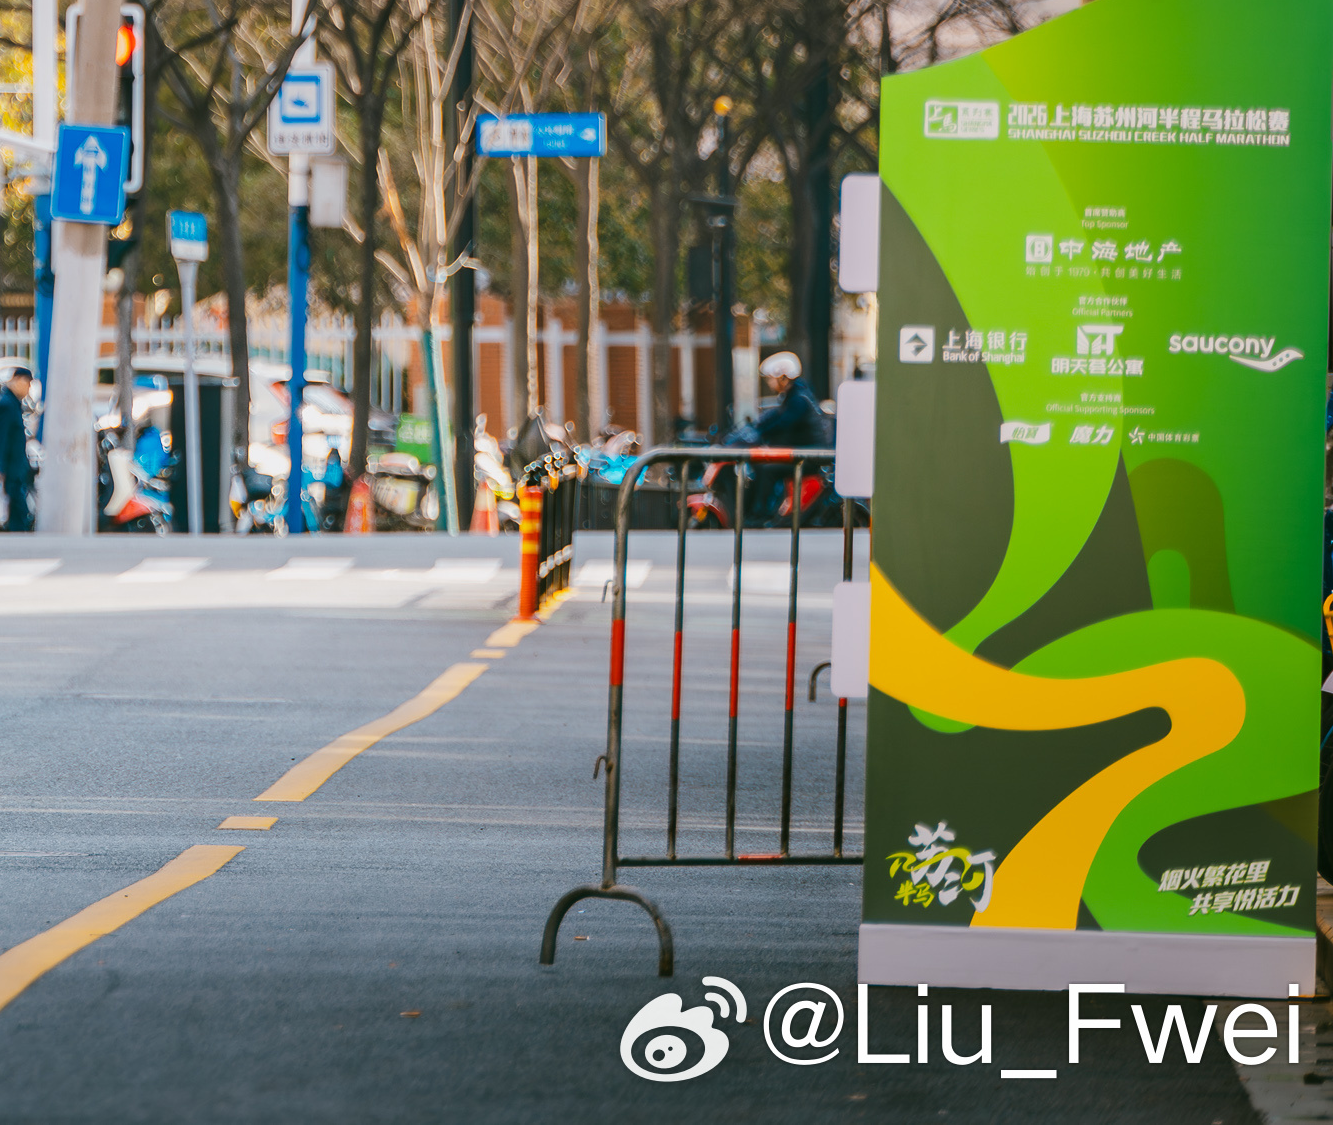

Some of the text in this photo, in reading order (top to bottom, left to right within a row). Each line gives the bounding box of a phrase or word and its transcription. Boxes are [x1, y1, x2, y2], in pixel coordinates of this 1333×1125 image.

[1007, 128, 1290, 146] SHANGHAI SUZHOU CREEK HALF MARATHON
[1058, 238, 1182, 263] 中海地产
[1072, 308, 1133, 318] Official Partners
[942, 329, 1027, 351] 上海银行
[1168, 333, 1276, 359] saucony
[942, 351, 1025, 365] Bank of Shanghai
[1046, 403, 1155, 415] Official Supporting Sponsors
[1069, 425, 1114, 444] 魔力
[1158, 860, 1271, 892] 烟火繁花里
[1189, 885, 1301, 916] 共享悦活力
